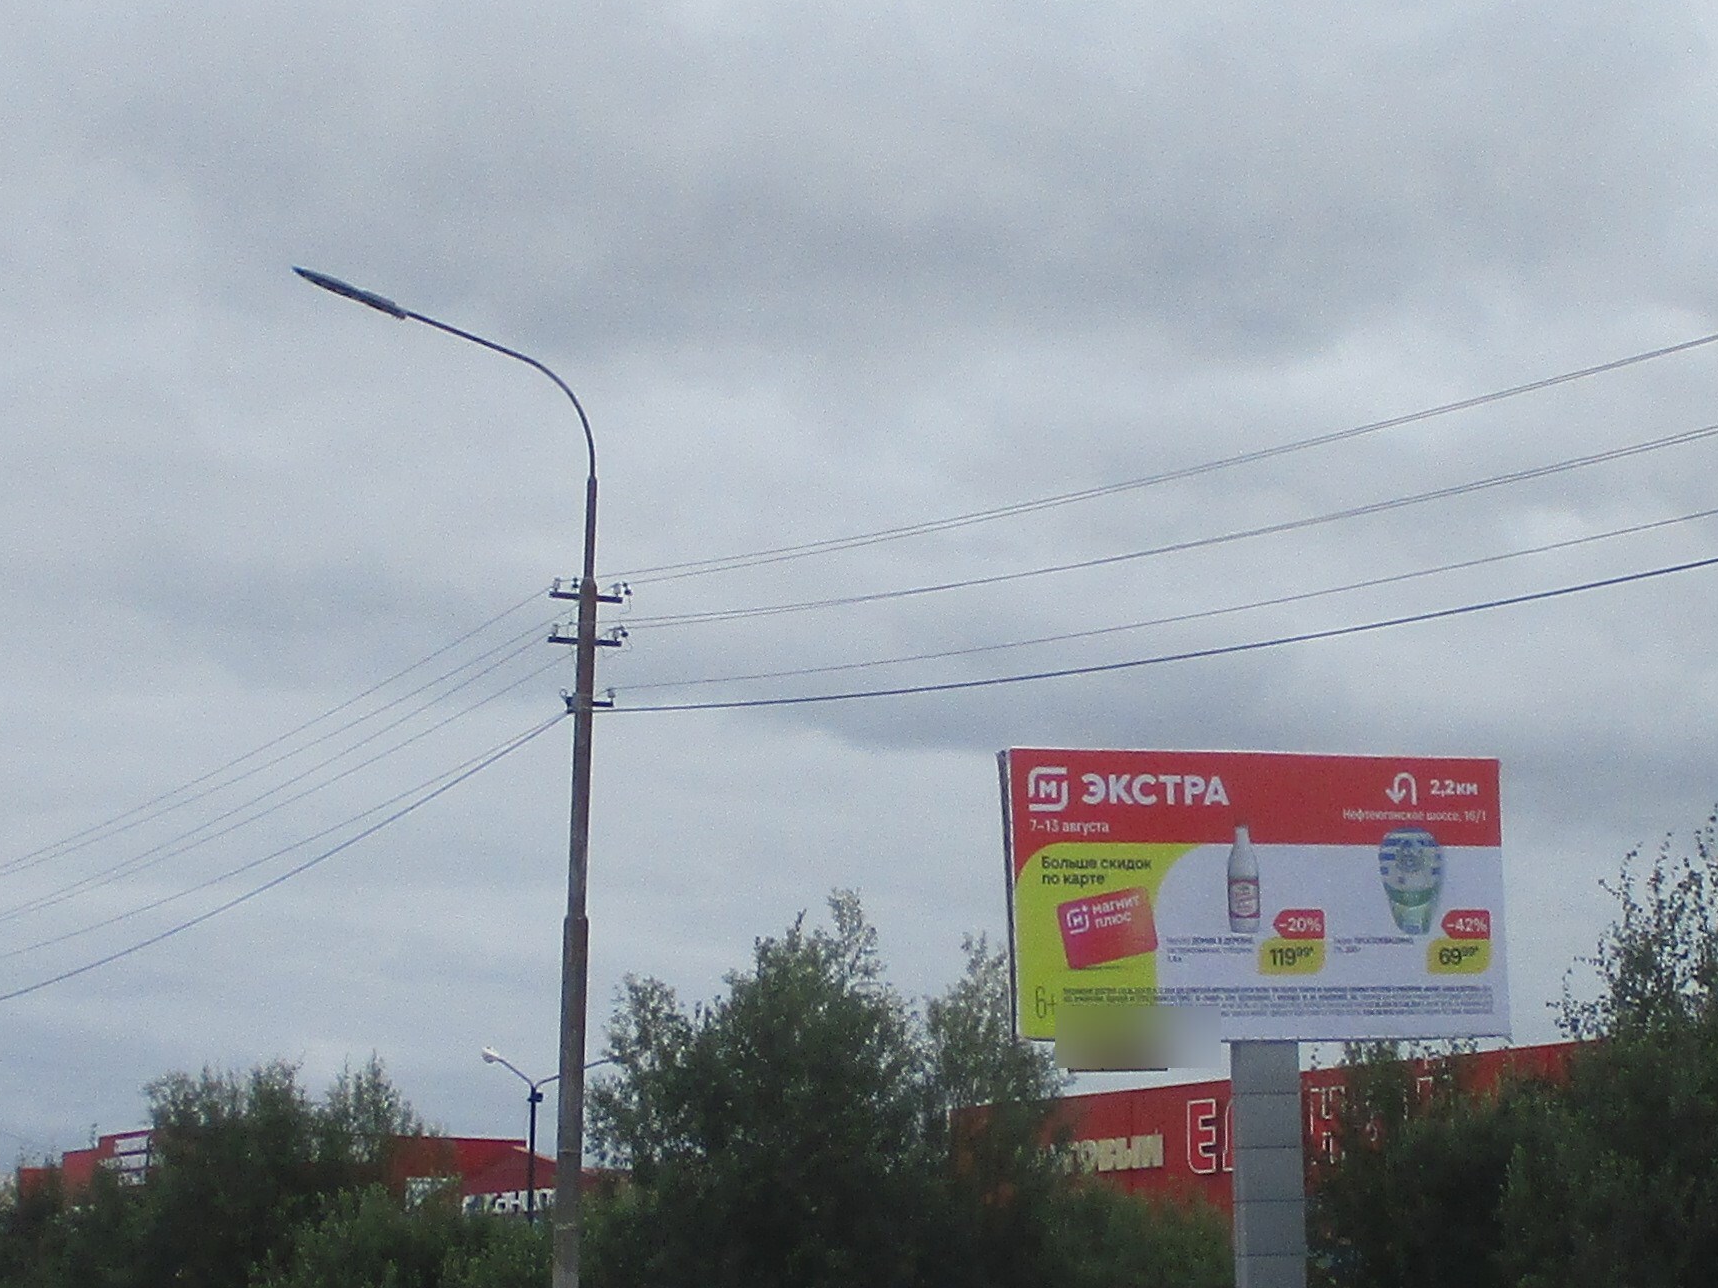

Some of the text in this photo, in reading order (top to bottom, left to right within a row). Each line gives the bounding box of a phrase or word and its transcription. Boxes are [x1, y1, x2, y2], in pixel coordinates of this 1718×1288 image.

[1081, 773, 1230, 806] ЭКСТРА
[1062, 821, 1110, 836] августа
[1041, 856, 1152, 871] Больше скидок
[1042, 873, 1105, 888] по карте
[1035, 985, 1057, 1019] 6+
